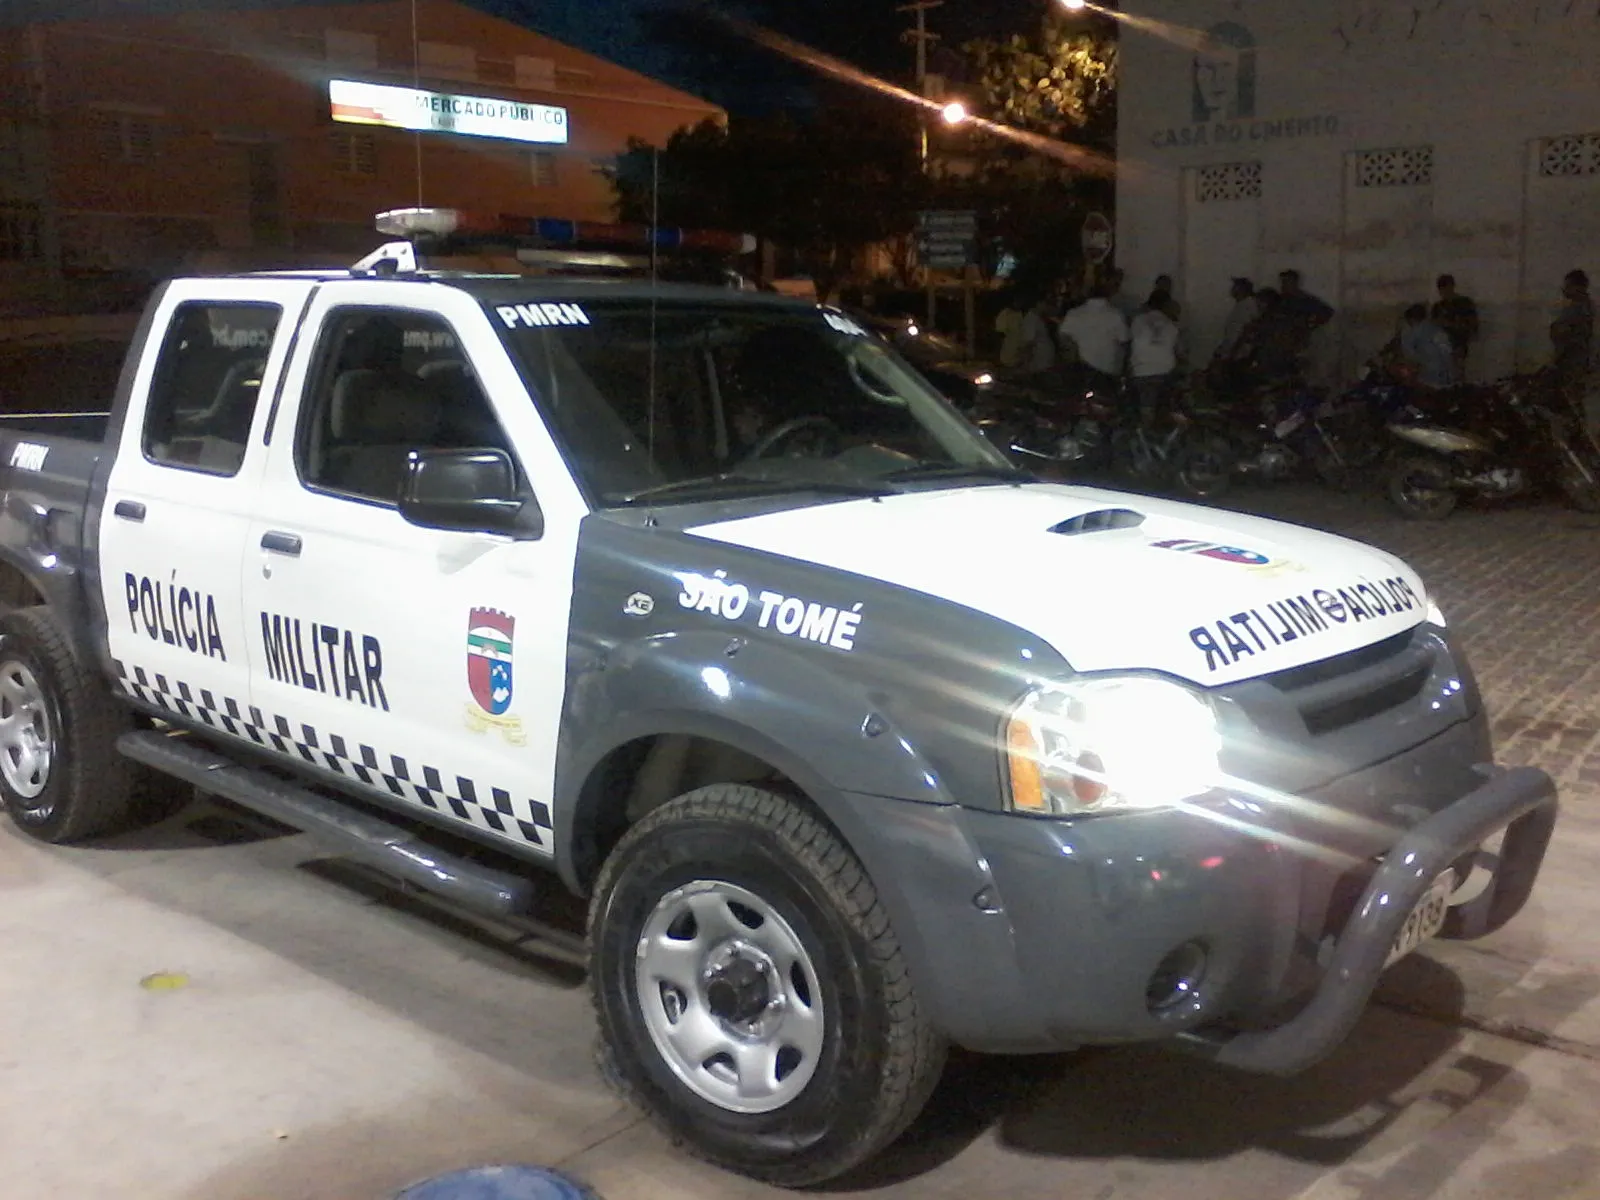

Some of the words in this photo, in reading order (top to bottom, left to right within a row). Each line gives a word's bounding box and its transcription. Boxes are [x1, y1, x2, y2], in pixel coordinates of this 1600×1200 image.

[415, 96, 495, 117] MERCADO
[1152, 126, 1208, 148] CASA
[1215, 123, 1243, 142] DO
[496, 303, 590, 329] PMRN
[10, 441, 50, 472] PMRN
[674, 569, 749, 620] SÃO
[757, 590, 863, 651] TOMÉ
[124, 568, 228, 662] POLÍCIA
[260, 611, 390, 712] MILITAR
